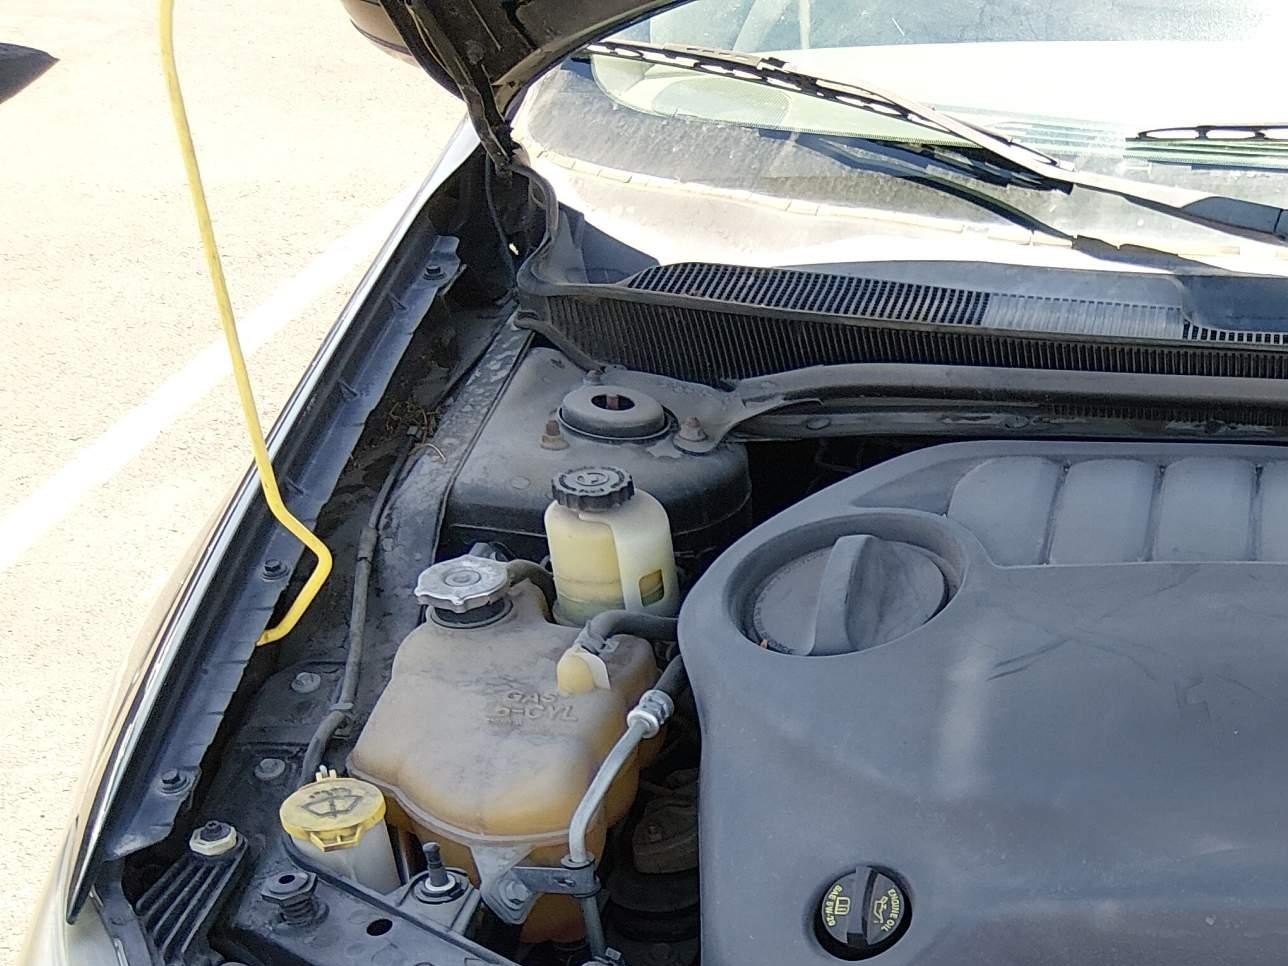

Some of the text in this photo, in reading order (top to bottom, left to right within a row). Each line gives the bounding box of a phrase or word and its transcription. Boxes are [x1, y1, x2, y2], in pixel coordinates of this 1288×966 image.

[828, 884, 843, 899] SAE
[881, 888, 900, 932] ENGINE OIL
